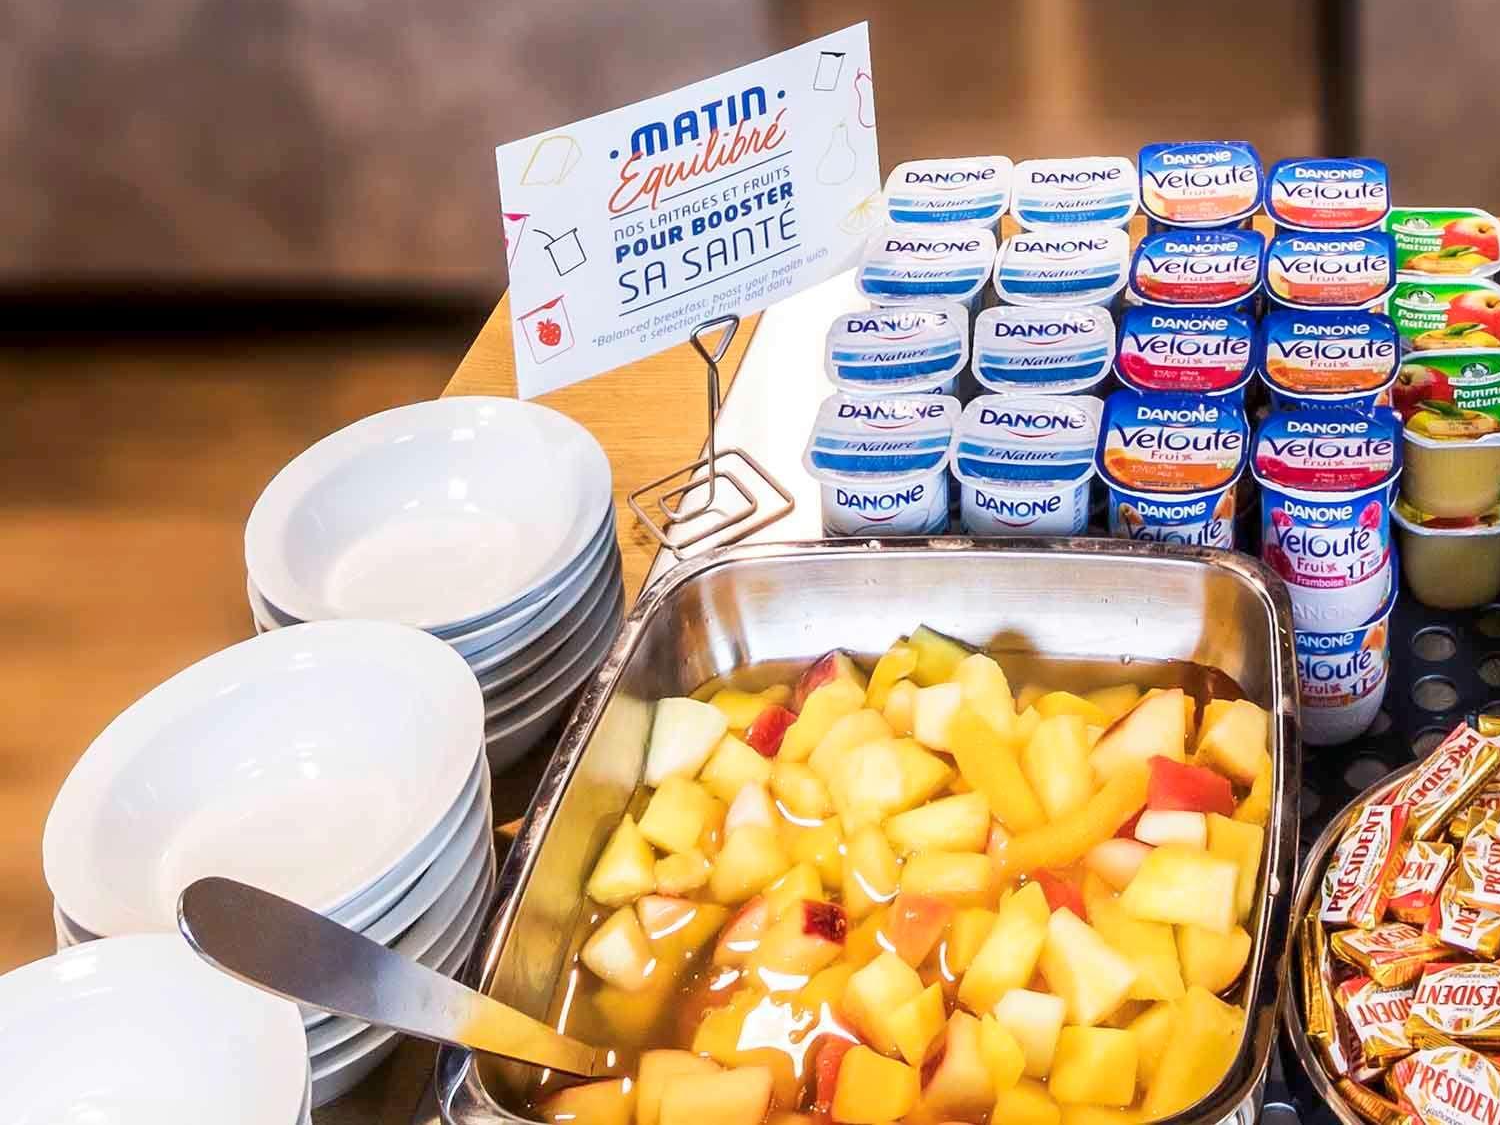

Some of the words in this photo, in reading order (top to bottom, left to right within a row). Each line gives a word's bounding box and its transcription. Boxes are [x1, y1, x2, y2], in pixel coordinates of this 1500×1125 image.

[630, 86, 767, 161] MATIN
[614, 220, 645, 243] NOS
[650, 194, 718, 229] LAITAGES
[723, 187, 738, 201] ET
[743, 165, 791, 194] FRUITS
[615, 225, 683, 264] POUR
[691, 181, 794, 237] BOOSTER
[618, 260, 667, 305] SA
[681, 202, 797, 282] SANTÉ
[1396, 233, 1443, 245] Pomme
[1144, 253, 1257, 275] Velouté
[1273, 253, 1387, 275] Velouté
[713, 284, 743, 305] boost
[745, 273, 769, 293] your
[771, 258, 804, 280] health
[650, 316, 702, 340] selection
[704, 306, 717, 323] of
[717, 296, 742, 315] fruit
[745, 286, 764, 303] and
[767, 275, 794, 299] dairy
[1398, 309, 1449, 322] Pomme
[1129, 332, 1249, 356] Velouté
[1273, 338, 1393, 359] Velouté
[1113, 423, 1241, 452] Velouté
[1268, 438, 1392, 459] Velouté
[1277, 526, 1371, 558] Velouté
